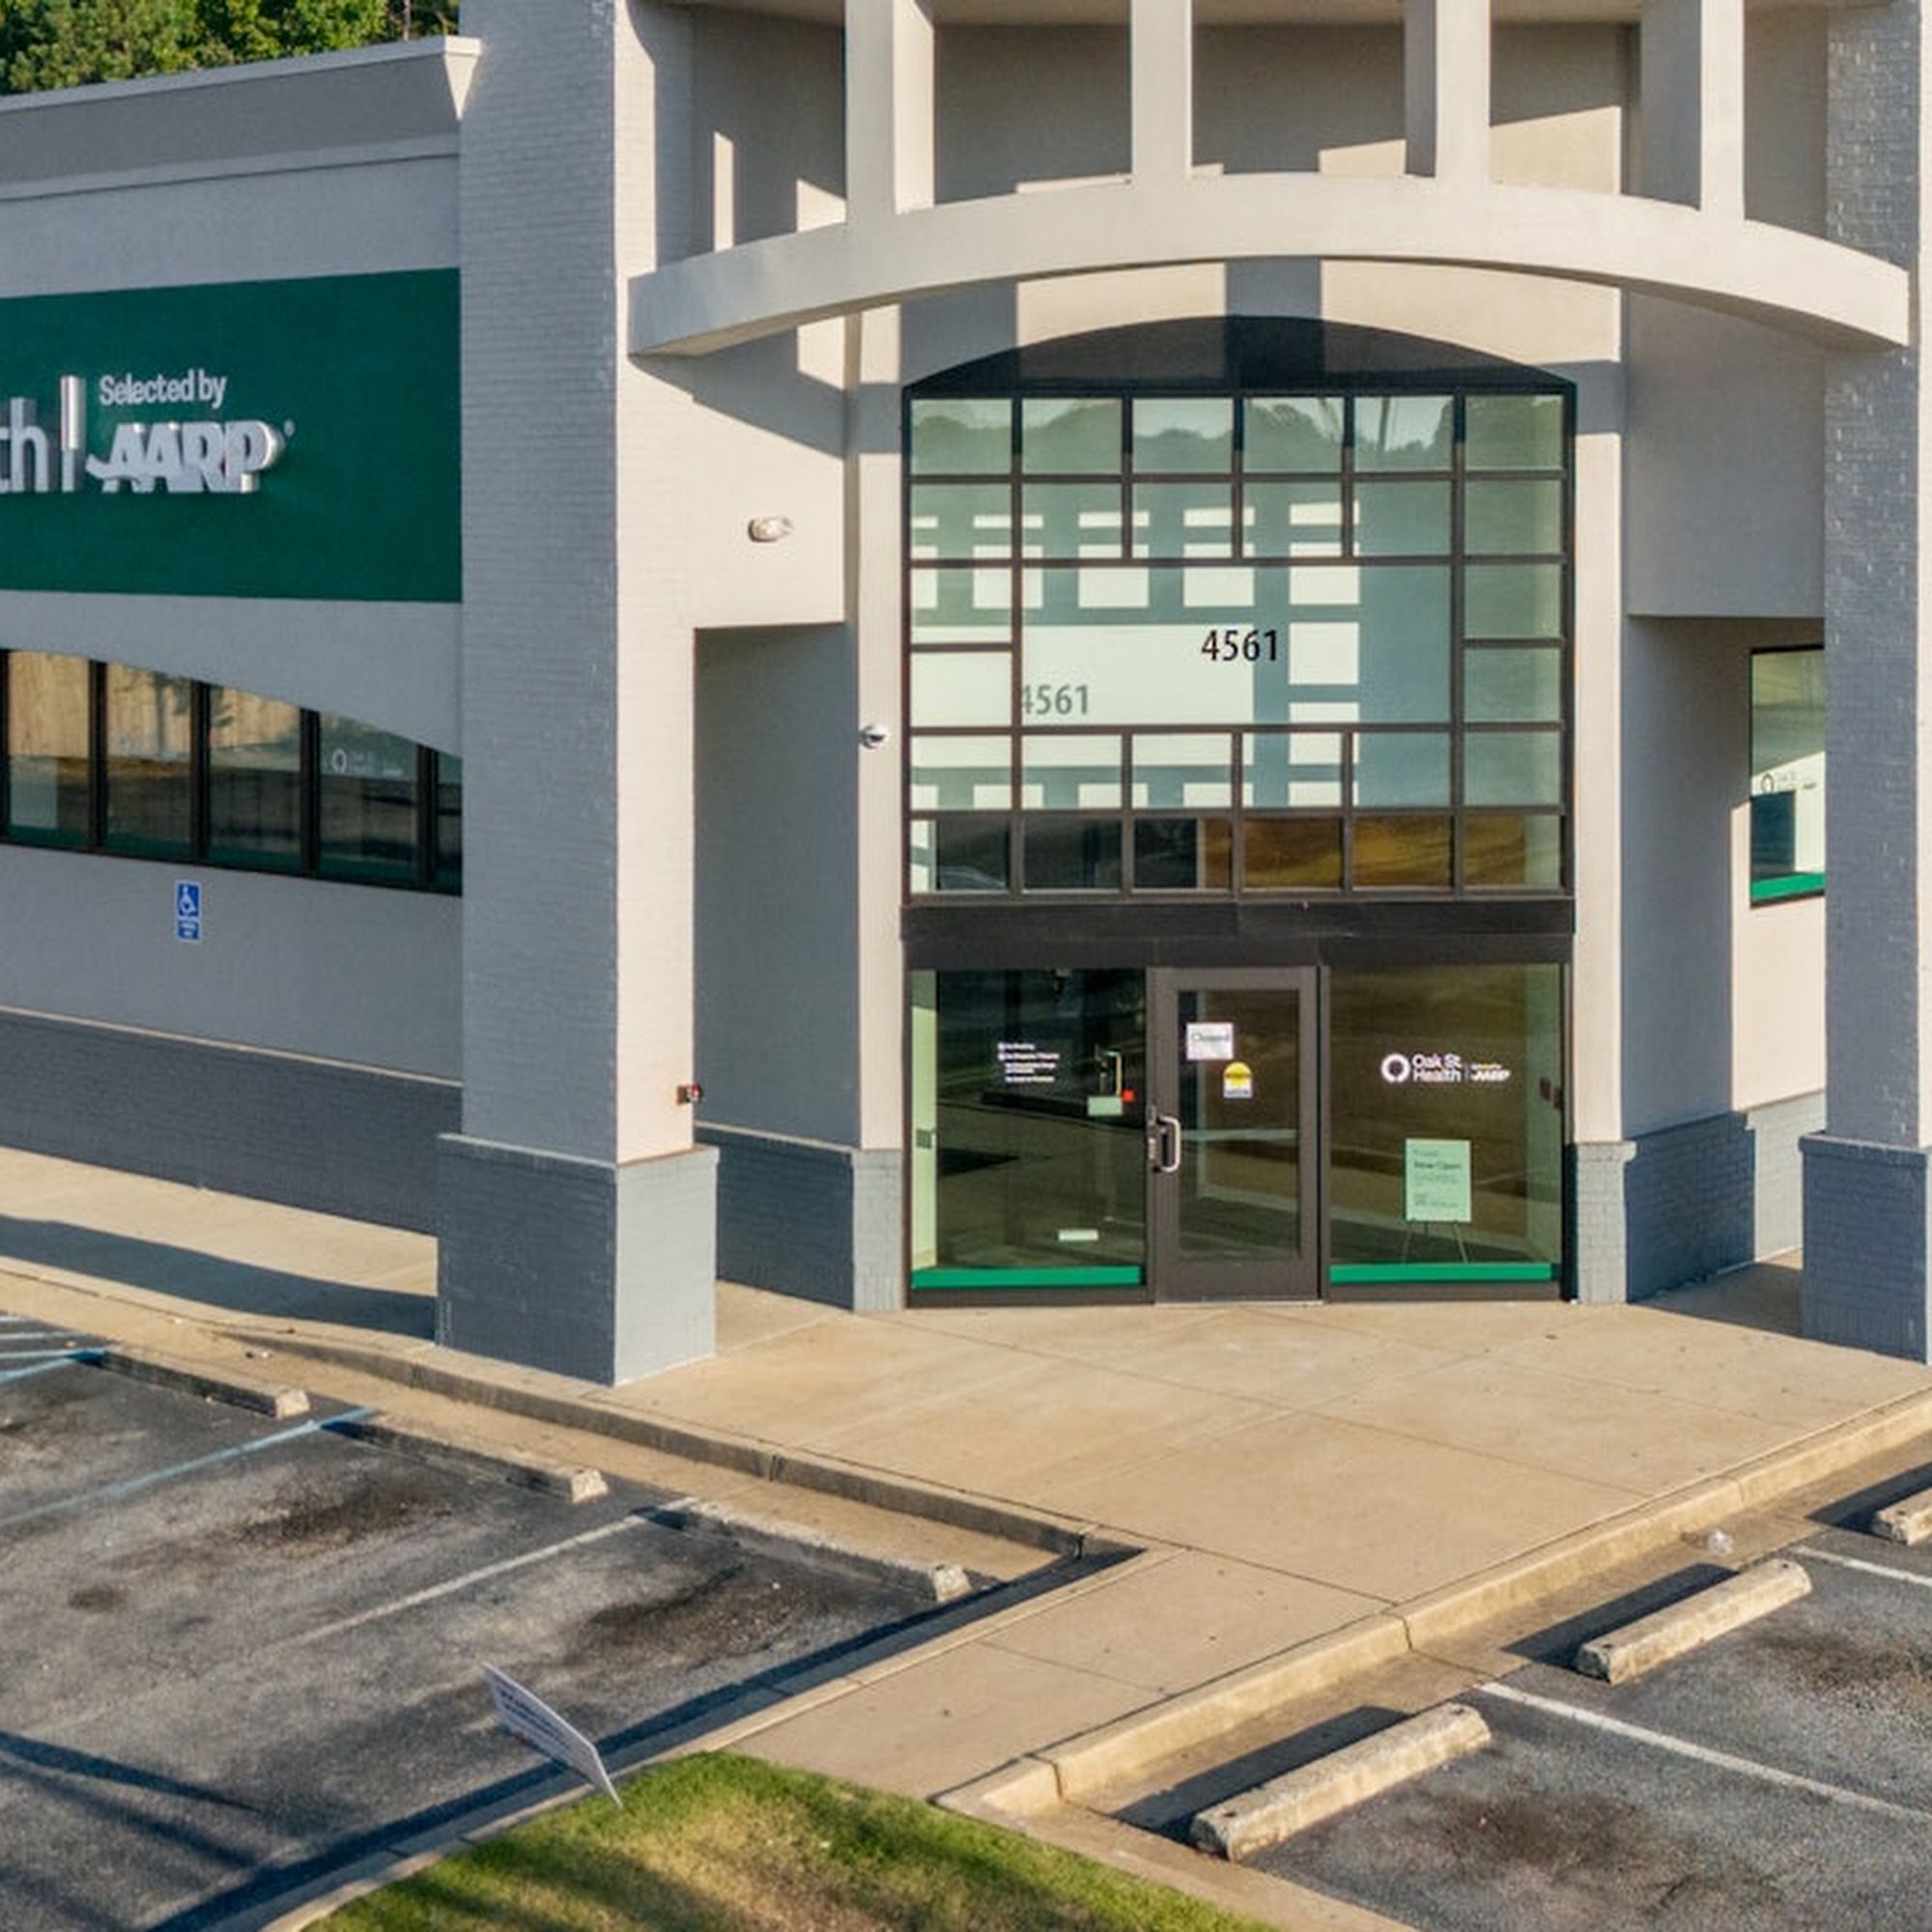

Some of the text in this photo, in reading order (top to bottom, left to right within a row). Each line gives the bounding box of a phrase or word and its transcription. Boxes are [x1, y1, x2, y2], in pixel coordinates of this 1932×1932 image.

[99, 368, 227, 409] Selected by
[1201, 629, 1278, 662] 4561
[1412, 1067, 1463, 1082] Health
